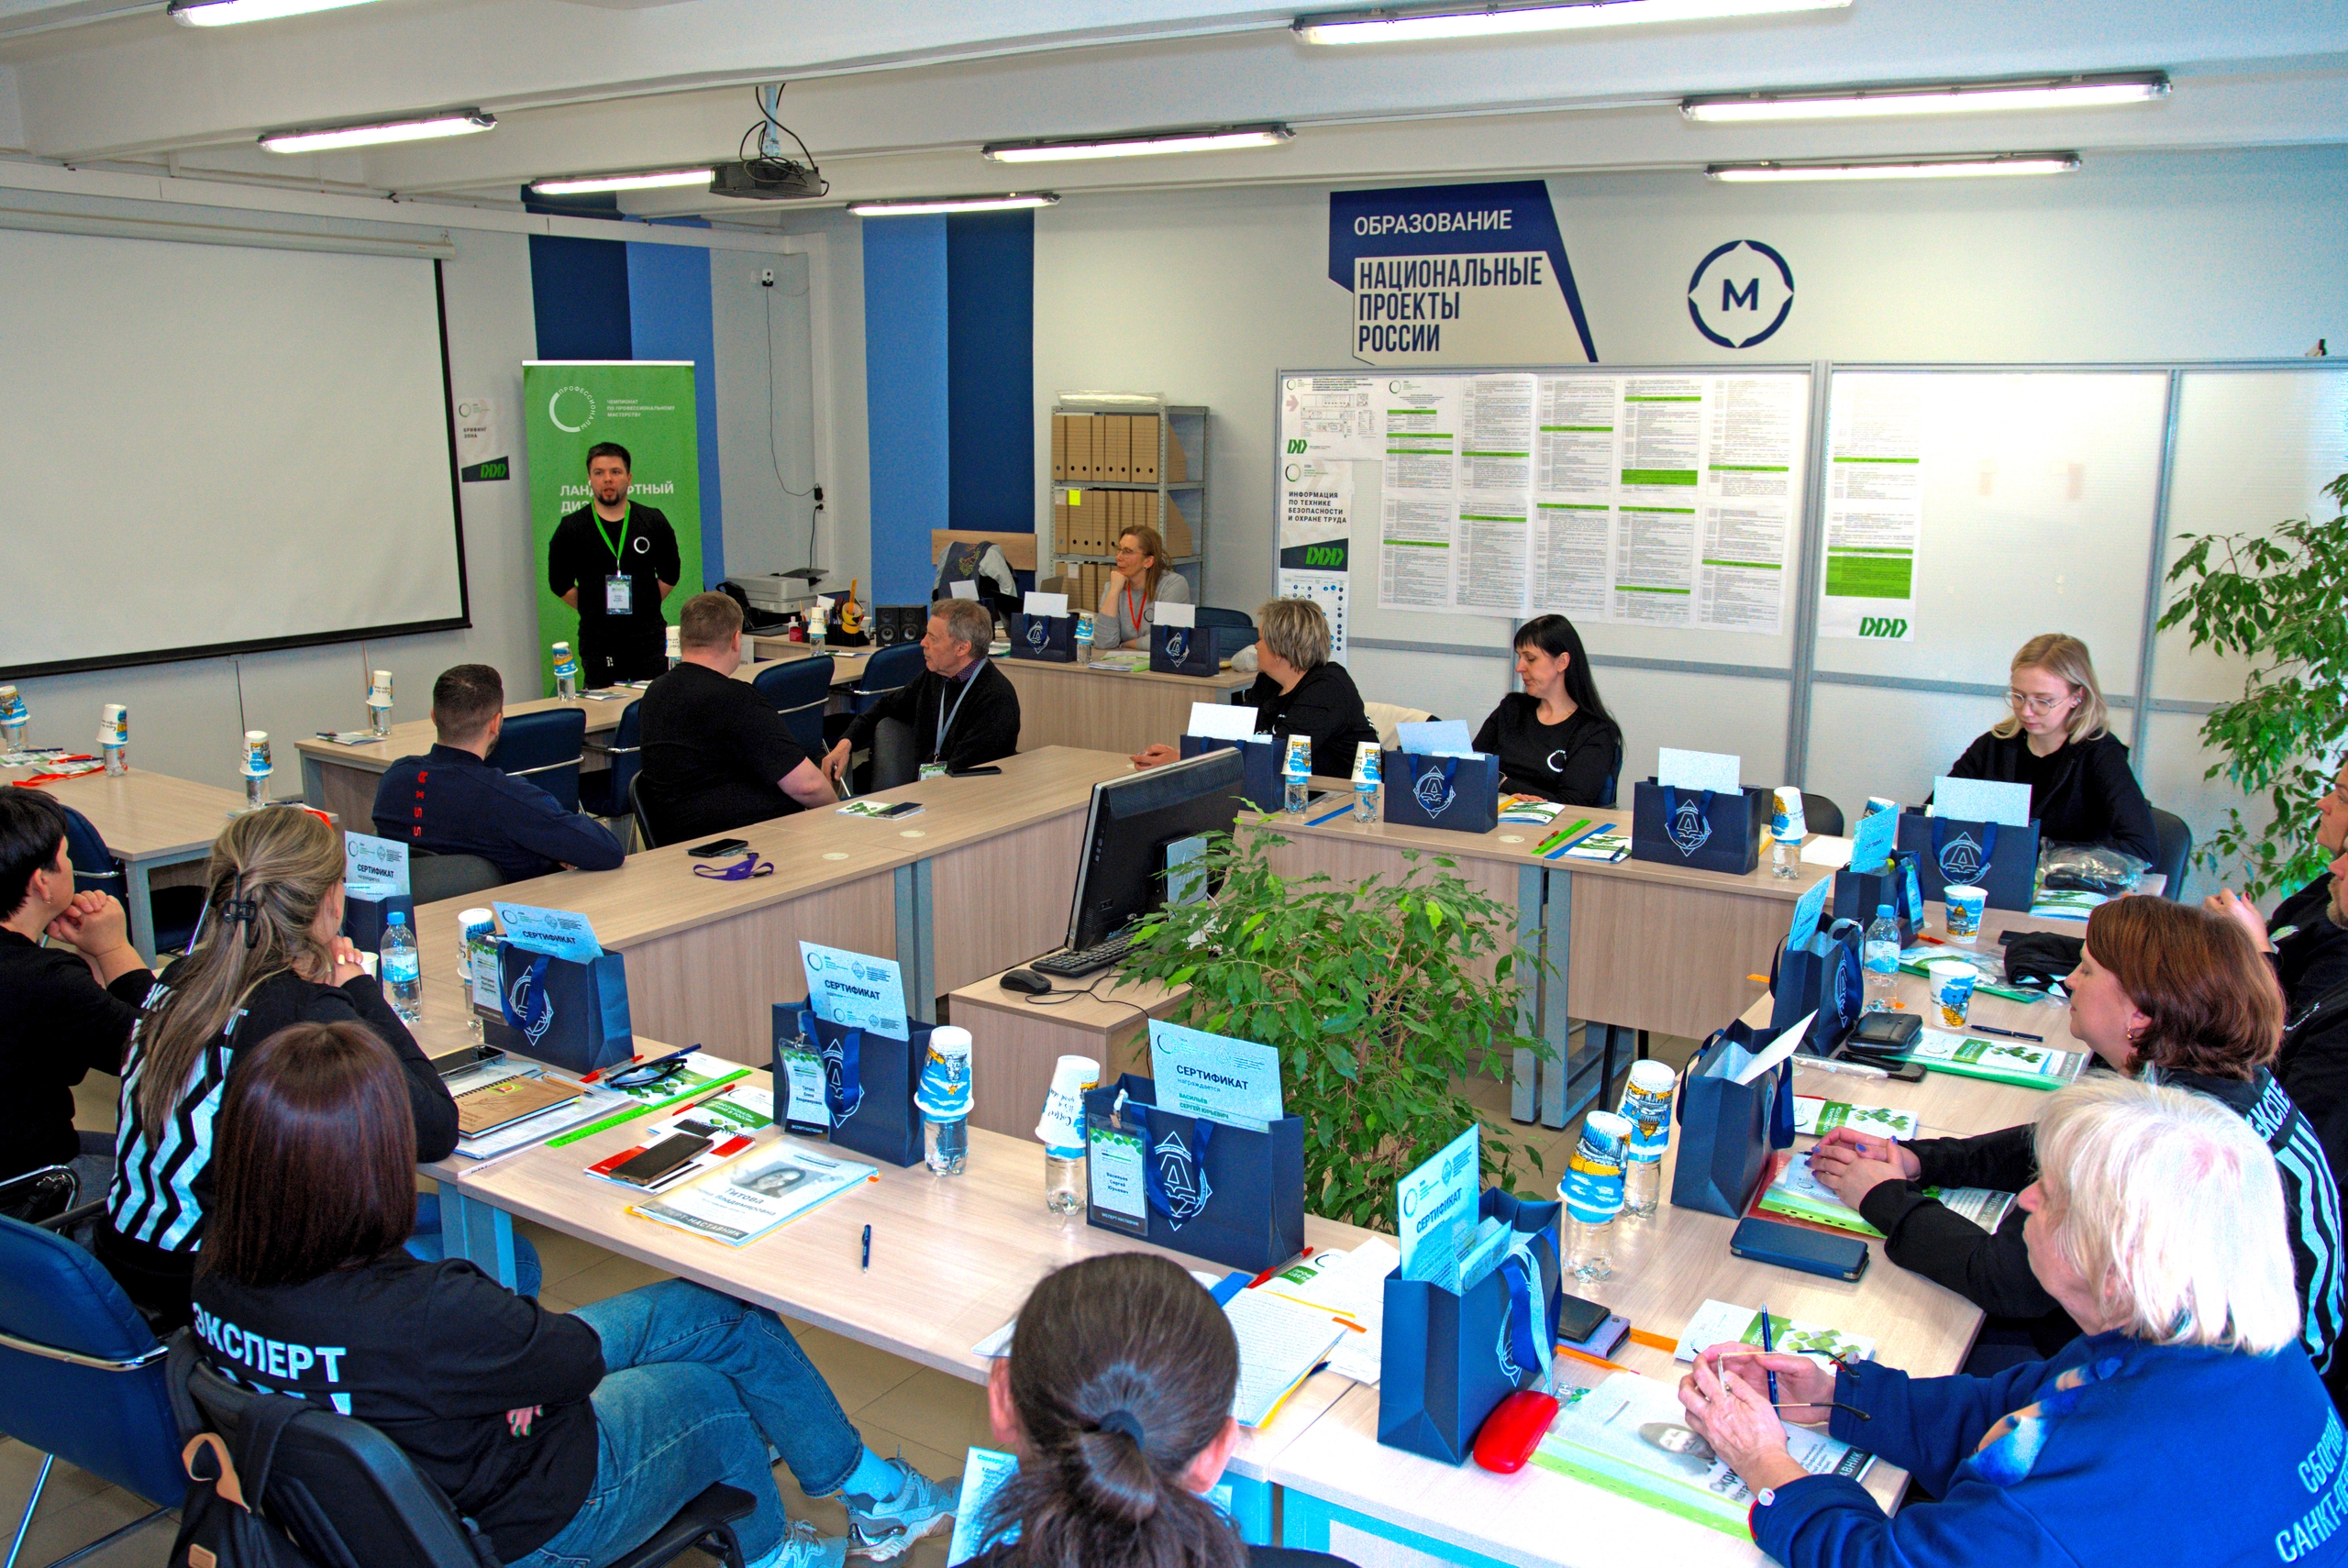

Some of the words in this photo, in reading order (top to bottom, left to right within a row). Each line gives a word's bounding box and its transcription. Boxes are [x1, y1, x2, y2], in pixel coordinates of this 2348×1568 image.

[1354, 209, 1512, 236] ОБРАЗОВАНИЕ
[1359, 256, 1543, 291] НАЦИОНАЛЬНЫЕ
[1359, 292, 1460, 322] ПРОЕКТЫ
[1358, 324, 1441, 352] РОССИИ
[357, 864, 394, 878] СЕРТИФИКАТ
[523, 931, 576, 944] СЕРТИФИКАТ
[825, 979, 880, 1000] СЕРТИФИКАТ
[1177, 1065, 1248, 1090] СЕРТИФИКАТ
[1178, 1078, 1221, 1092] награждается
[1416, 1187, 1463, 1233] СЕРТИФИКАТ
[192, 1301, 347, 1383] ЭКСПЕРТ
